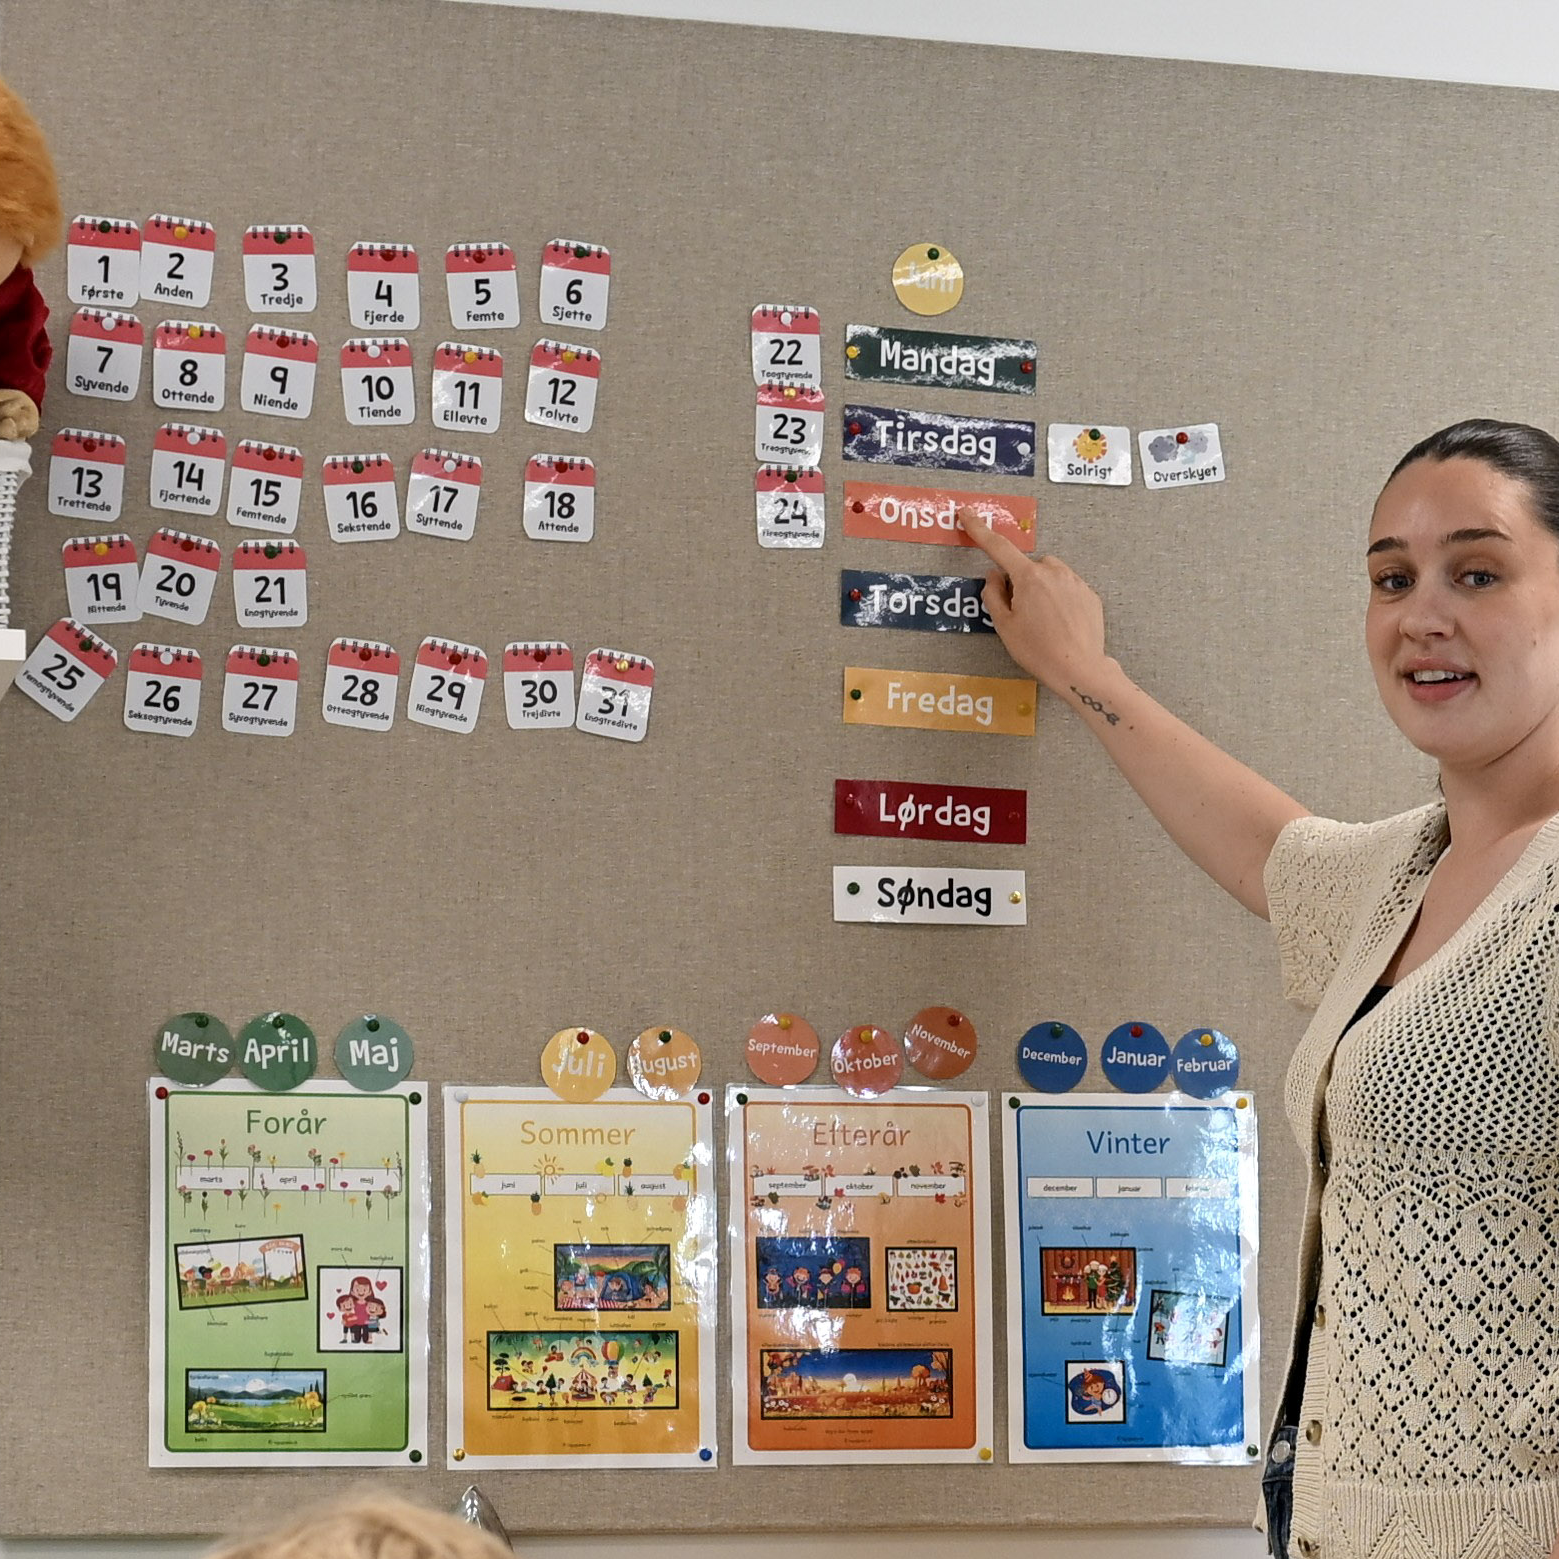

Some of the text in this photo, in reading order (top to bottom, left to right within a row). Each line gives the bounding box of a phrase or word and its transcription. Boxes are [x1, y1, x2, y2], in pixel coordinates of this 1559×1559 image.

[97, 255, 110, 284] 1
[167, 253, 185, 280] 2
[271, 263, 289, 291] 3
[81, 285, 124, 300] Første
[154, 283, 194, 300] Anden
[260, 294, 303, 308] Tredje
[374, 280, 393, 308] 4
[474, 278, 492, 306] 5
[565, 279, 583, 305] 6
[364, 310, 405, 324] Fjerde
[466, 310, 505, 322] Femte
[552, 306, 592, 323] Sjette
[96, 346, 113, 373] 7
[769, 339, 803, 366] 22
[879, 339, 997, 386] Mandag
[75, 375, 129, 394] Syvende
[179, 359, 199, 386] 8
[270, 366, 289, 395] 9
[162, 388, 214, 404] Ottende
[253, 394, 298, 411] Niende
[361, 375, 395, 403] 10
[454, 380, 481, 410] 11
[548, 378, 577, 406] 12
[358, 406, 402, 418] Tiende
[443, 410, 488, 426] Ellevte
[538, 406, 579, 425] Tolvte
[773, 413, 807, 445] 23
[875, 419, 997, 466] Tirsdag
[71, 467, 103, 498] 13
[173, 460, 204, 491] 14
[1067, 463, 1112, 480] Solrigt
[1153, 466, 1217, 483] Overskyet
[57, 496, 112, 512] Trettende
[159, 490, 211, 506] Fjortende
[250, 479, 282, 507] 15
[346, 491, 378, 519] 16
[429, 485, 459, 514] 17
[544, 491, 576, 520] 18
[236, 507, 287, 525] Femtende
[416, 513, 463, 532] Syttende
[773, 498, 807, 527] 24
[337, 521, 391, 534] Sekstende
[538, 521, 579, 534] Attende
[87, 573, 122, 602] 19
[156, 565, 196, 597] 20
[254, 576, 285, 605] 21
[154, 596, 189, 612] Tyvende
[41, 653, 85, 691] 25
[144, 680, 181, 712] 26
[241, 682, 278, 711] 27
[341, 675, 380, 706] 28
[427, 675, 466, 710] 29
[521, 680, 557, 708] 30
[598, 686, 630, 717] 31
[887, 682, 994, 726] Fredag
[878, 793, 991, 835] Lørdag
[877, 877, 992, 917] Søndag
[161, 1031, 230, 1064] Marts
[243, 1037, 309, 1070] April
[349, 1037, 399, 1072] Maj
[748, 1039, 817, 1059] September
[911, 1023, 971, 1059] November
[552, 1047, 606, 1079] Juli
[834, 1053, 899, 1074] Oktober
[1022, 1047, 1082, 1066] December
[1107, 1046, 1166, 1067] Januar
[1176, 1057, 1233, 1073] Februar
[246, 1108, 327, 1135] Forår
[520, 1120, 636, 1145] Sommer
[813, 1120, 911, 1147] Efterår
[1086, 1130, 1171, 1154] Vinter
[768, 1181, 807, 1191] september
[845, 1182, 875, 1191] oktober
[910, 1182, 947, 1190] november
[1043, 1184, 1077, 1192] december
